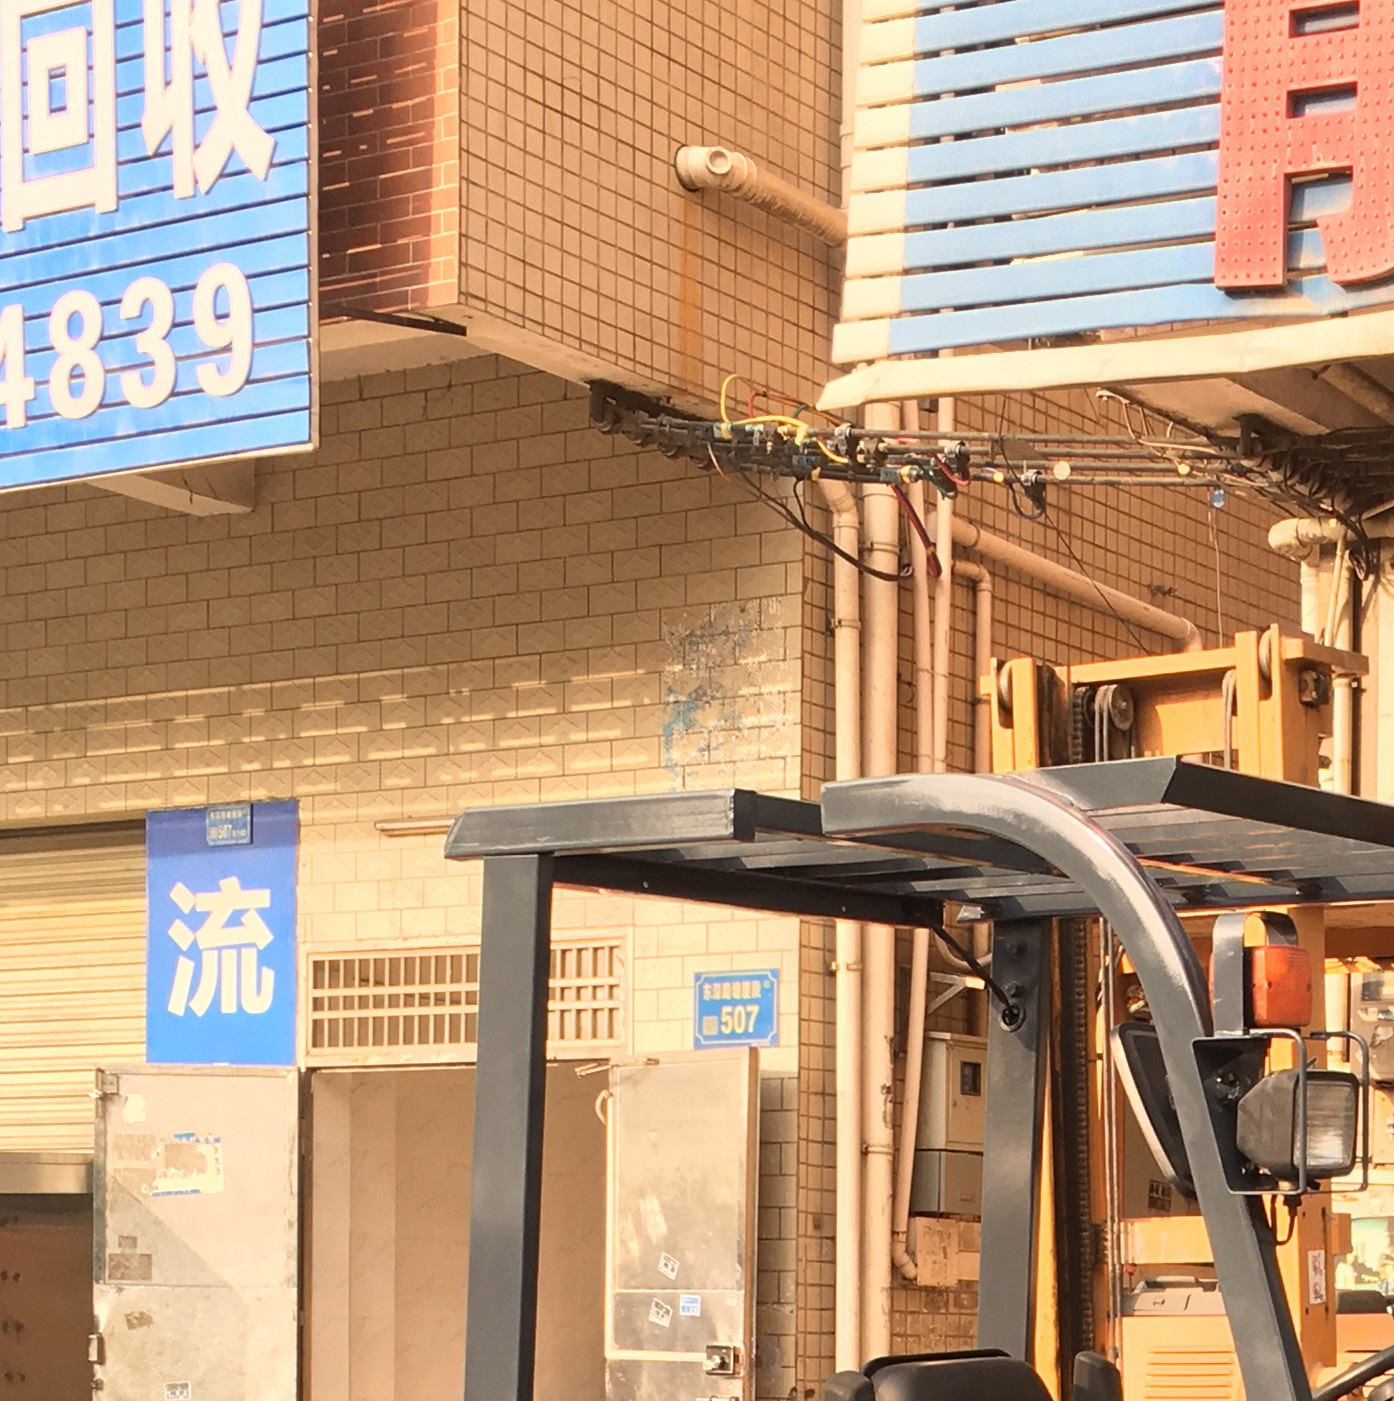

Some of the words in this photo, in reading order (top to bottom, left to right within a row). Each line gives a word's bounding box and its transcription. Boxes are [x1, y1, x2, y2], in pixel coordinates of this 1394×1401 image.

[0, 0, 276, 232] 回收
[167, 876, 275, 1018] 流
[720, 1004, 760, 1034] 507
